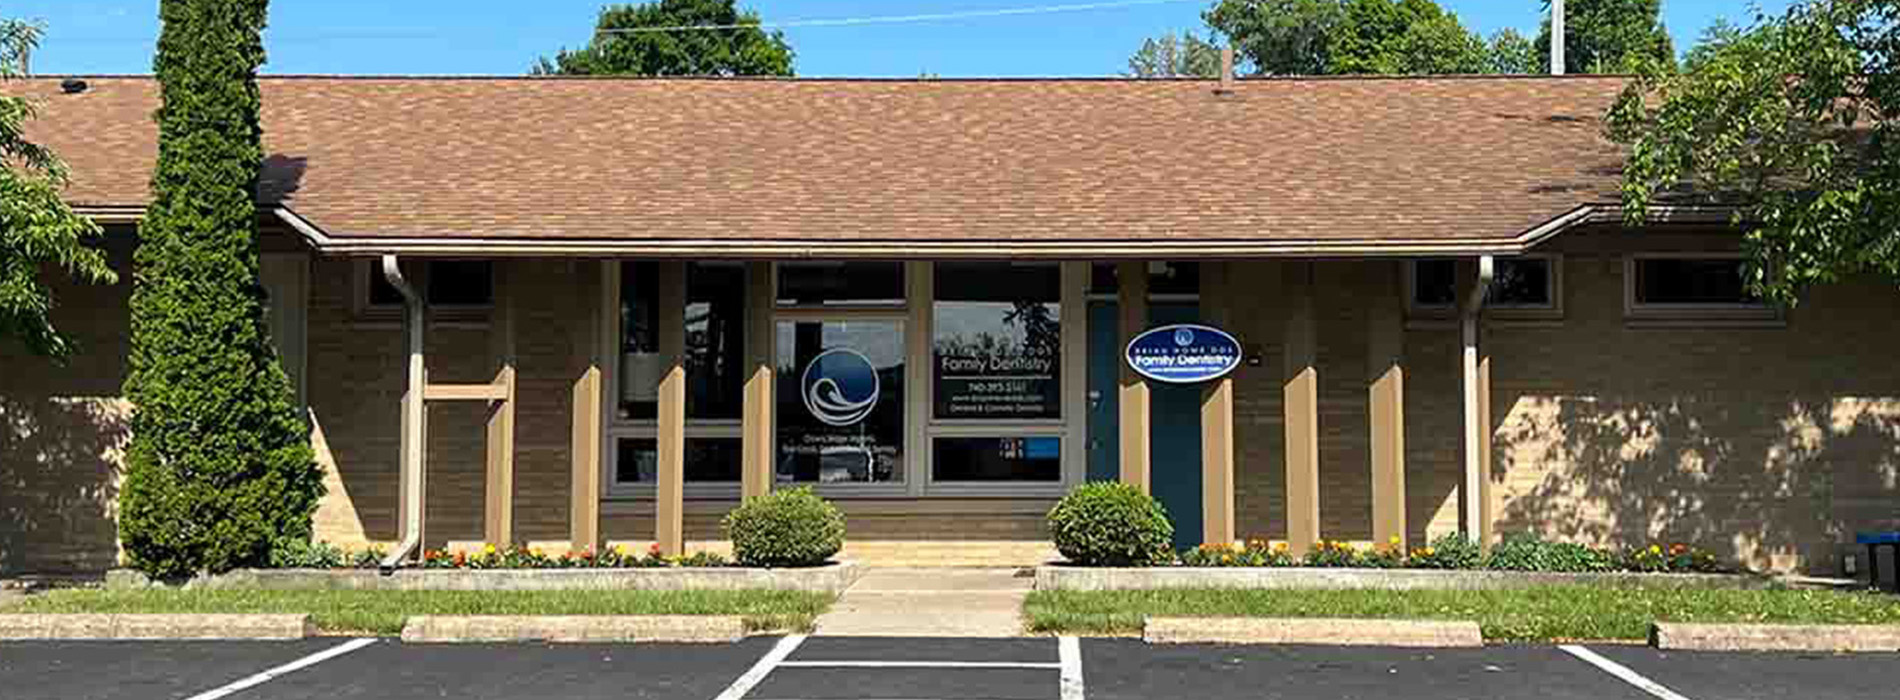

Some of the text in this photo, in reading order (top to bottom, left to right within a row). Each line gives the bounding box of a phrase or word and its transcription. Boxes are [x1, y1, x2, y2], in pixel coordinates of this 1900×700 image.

[941, 356, 1052, 374] Family Dentistry
[1135, 354, 1233, 367] Family Dentistry
